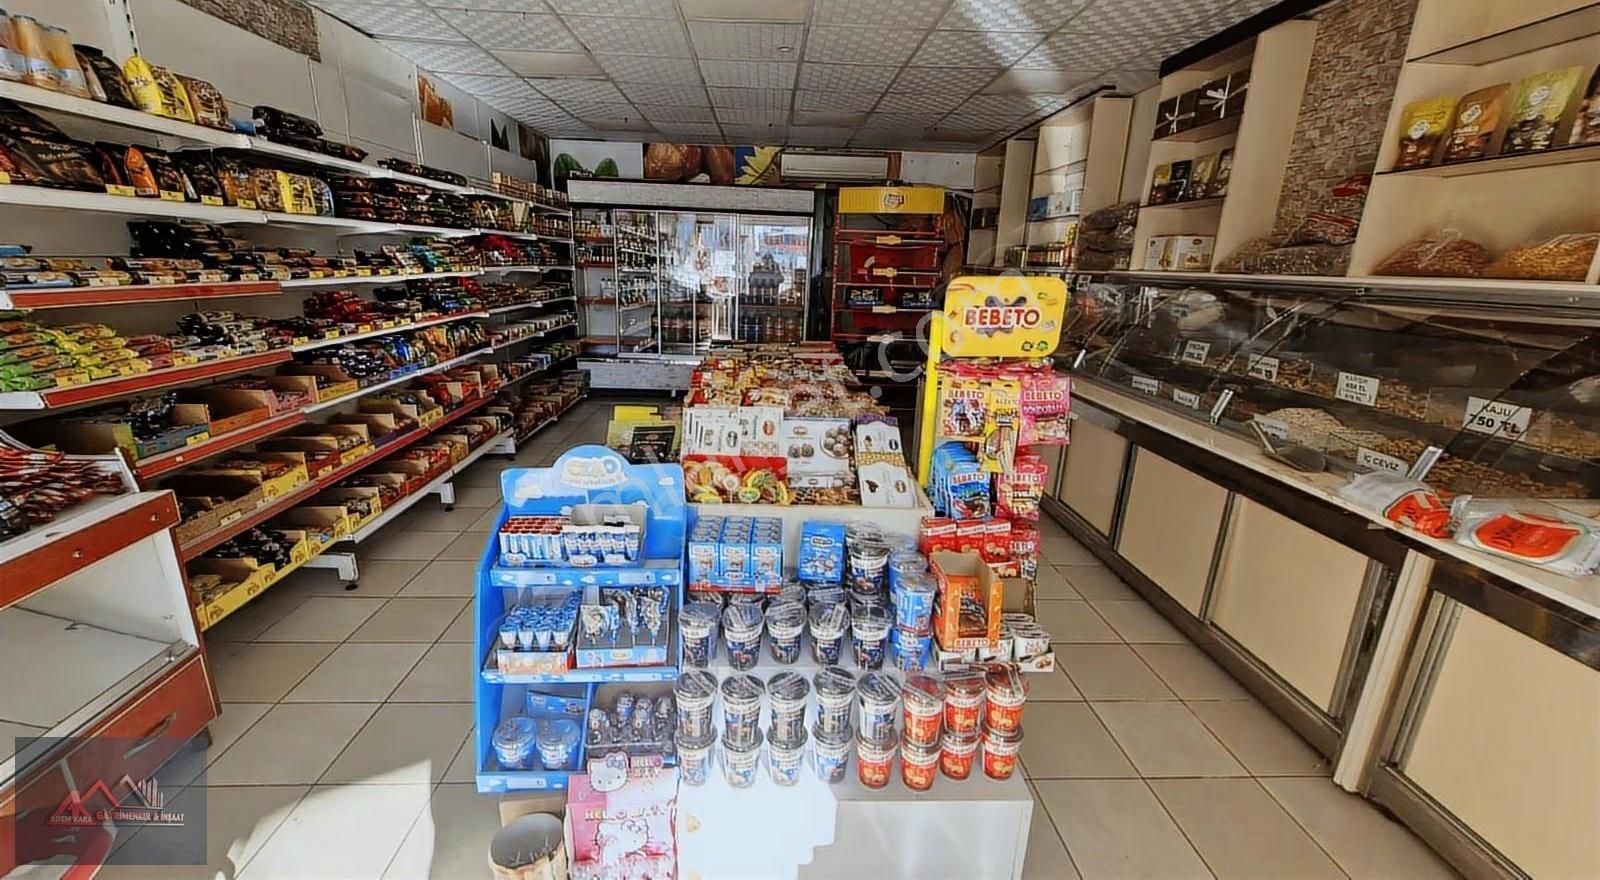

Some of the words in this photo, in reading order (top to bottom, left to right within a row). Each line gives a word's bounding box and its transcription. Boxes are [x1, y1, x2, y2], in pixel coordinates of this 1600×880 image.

[965, 308, 1040, 326] BEBETO
[948, 390, 985, 399] BEBETO
[1024, 391, 1062, 400] BEBETO
[1482, 402, 1512, 416] KAJU
[1469, 413, 1495, 428] 750
[1373, 457, 1400, 471] CEVİZ
[952, 473, 985, 484] BEBETO
[1004, 474, 1041, 483] BEBETO
[956, 640, 988, 648] BEBETO
